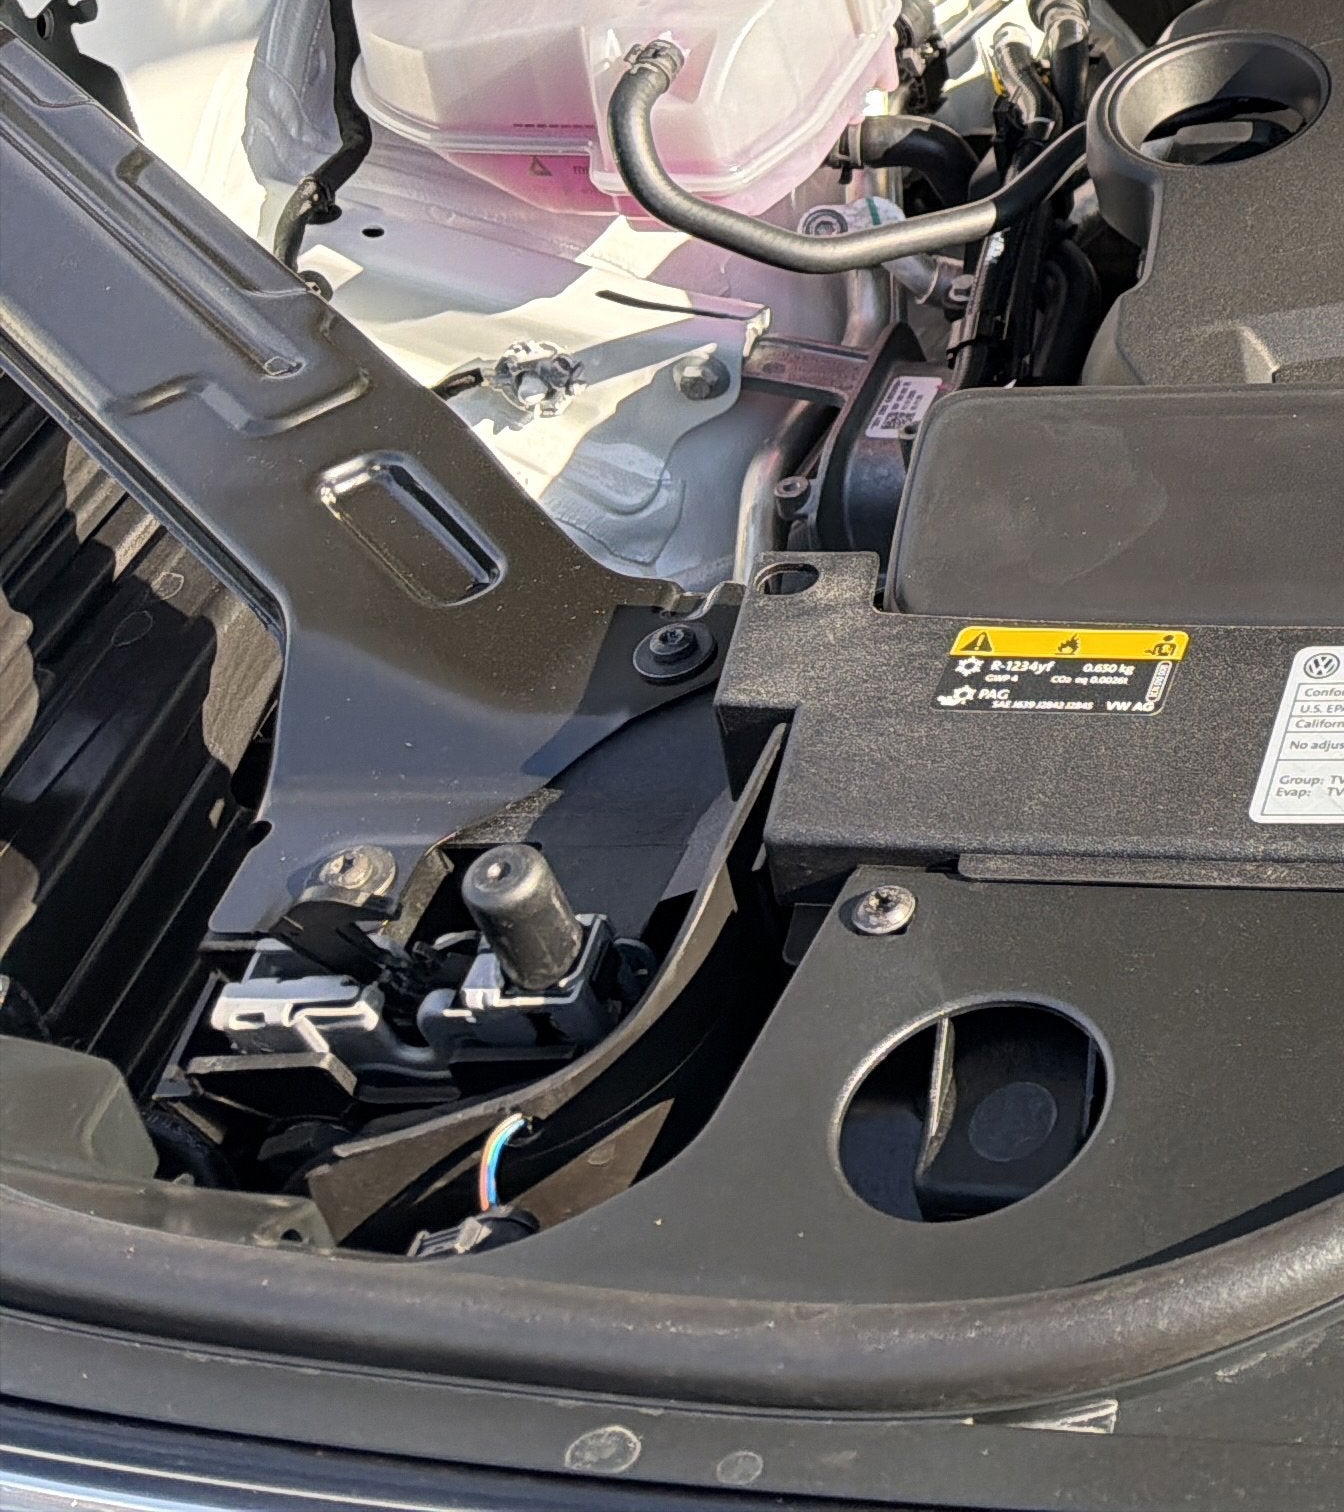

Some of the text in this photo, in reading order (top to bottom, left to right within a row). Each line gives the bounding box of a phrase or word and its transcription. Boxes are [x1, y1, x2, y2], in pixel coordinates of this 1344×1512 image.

[991, 660, 1056, 675] R-1234yf
[1118, 664, 1135, 675] kg
[977, 689, 1010, 700] PAG
[1105, 701, 1154, 711] VW AG
[1300, 705, 1322, 713] U.S.
[1290, 740, 1308, 750] No
[1279, 775, 1324, 787] Group:
[1276, 787, 1311, 799] Evap:
